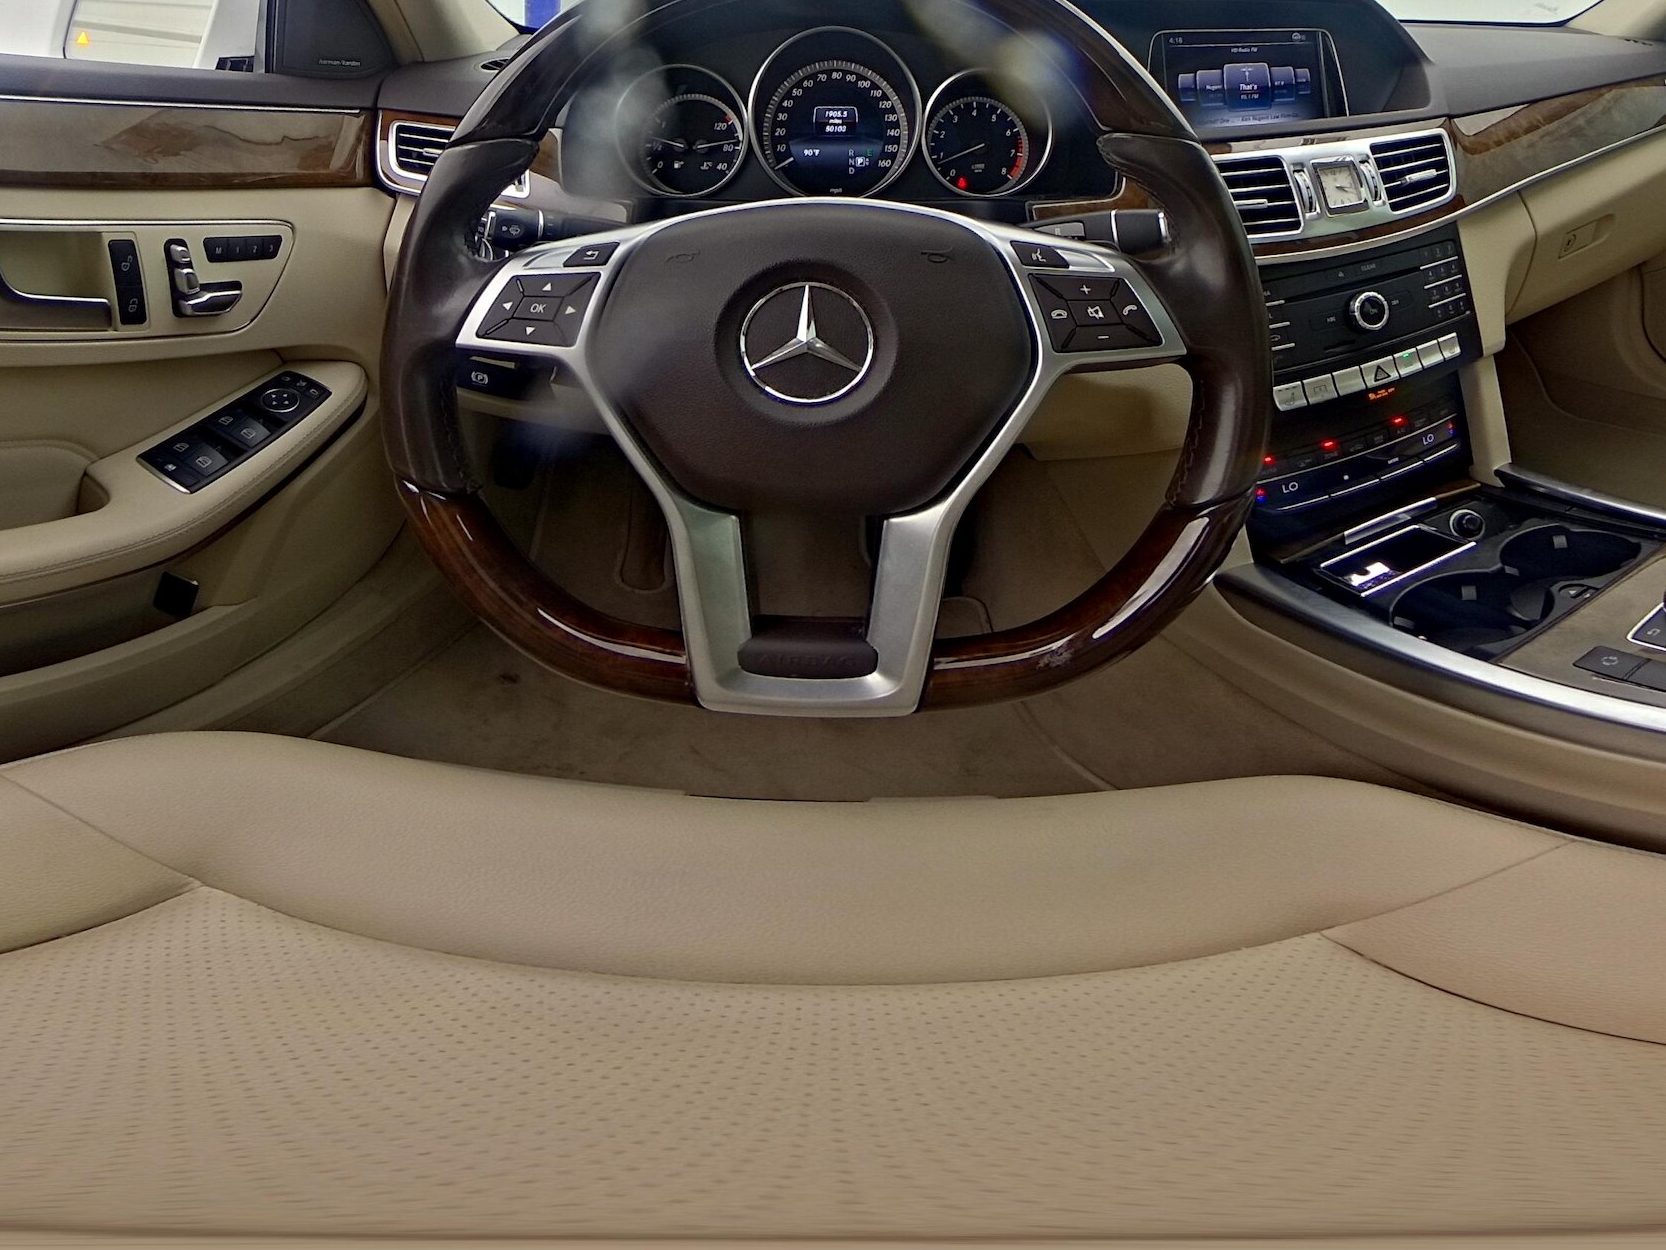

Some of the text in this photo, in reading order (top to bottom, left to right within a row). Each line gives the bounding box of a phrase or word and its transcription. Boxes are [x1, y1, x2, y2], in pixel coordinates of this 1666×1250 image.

[816, 73, 827, 82] 70
[831, 71, 843, 80] 80
[845, 73, 856, 82] 90
[802, 79, 814, 87] 60
[857, 80, 871, 88] 100
[1239, 83, 1258, 91] That's
[791, 88, 803, 96] 50
[870, 89, 882, 97] 110
[782, 99, 794, 107] 40
[878, 100, 892, 109] 120
[776, 113, 788, 121] 30
[825, 110, 848, 118] 1905.5
[884, 113, 898, 122] 130
[991, 114, 997, 122] 5
[952, 115, 958, 123] 3
[714, 122, 728, 130] 120
[775, 128, 786, 136] 20
[886, 128, 900, 136] 140
[939, 130, 946, 138] 2
[1005, 129, 1011, 137] 6
[722, 144, 734, 152] 80
[776, 144, 786, 152] 10
[884, 144, 898, 152] 150
[867, 149, 872, 157] E
[1010, 150, 1016, 158] 7
[716, 162, 728, 170] 40
[878, 159, 891, 168] 160
[950, 169, 956, 177] 0
[1001, 167, 1007, 175] 8
[252, 245, 258, 253] 2
[269, 244, 274, 252] 3
[530, 303, 547, 313] OK
[1422, 434, 1434, 446] LO
[1282, 482, 1298, 493] LO
